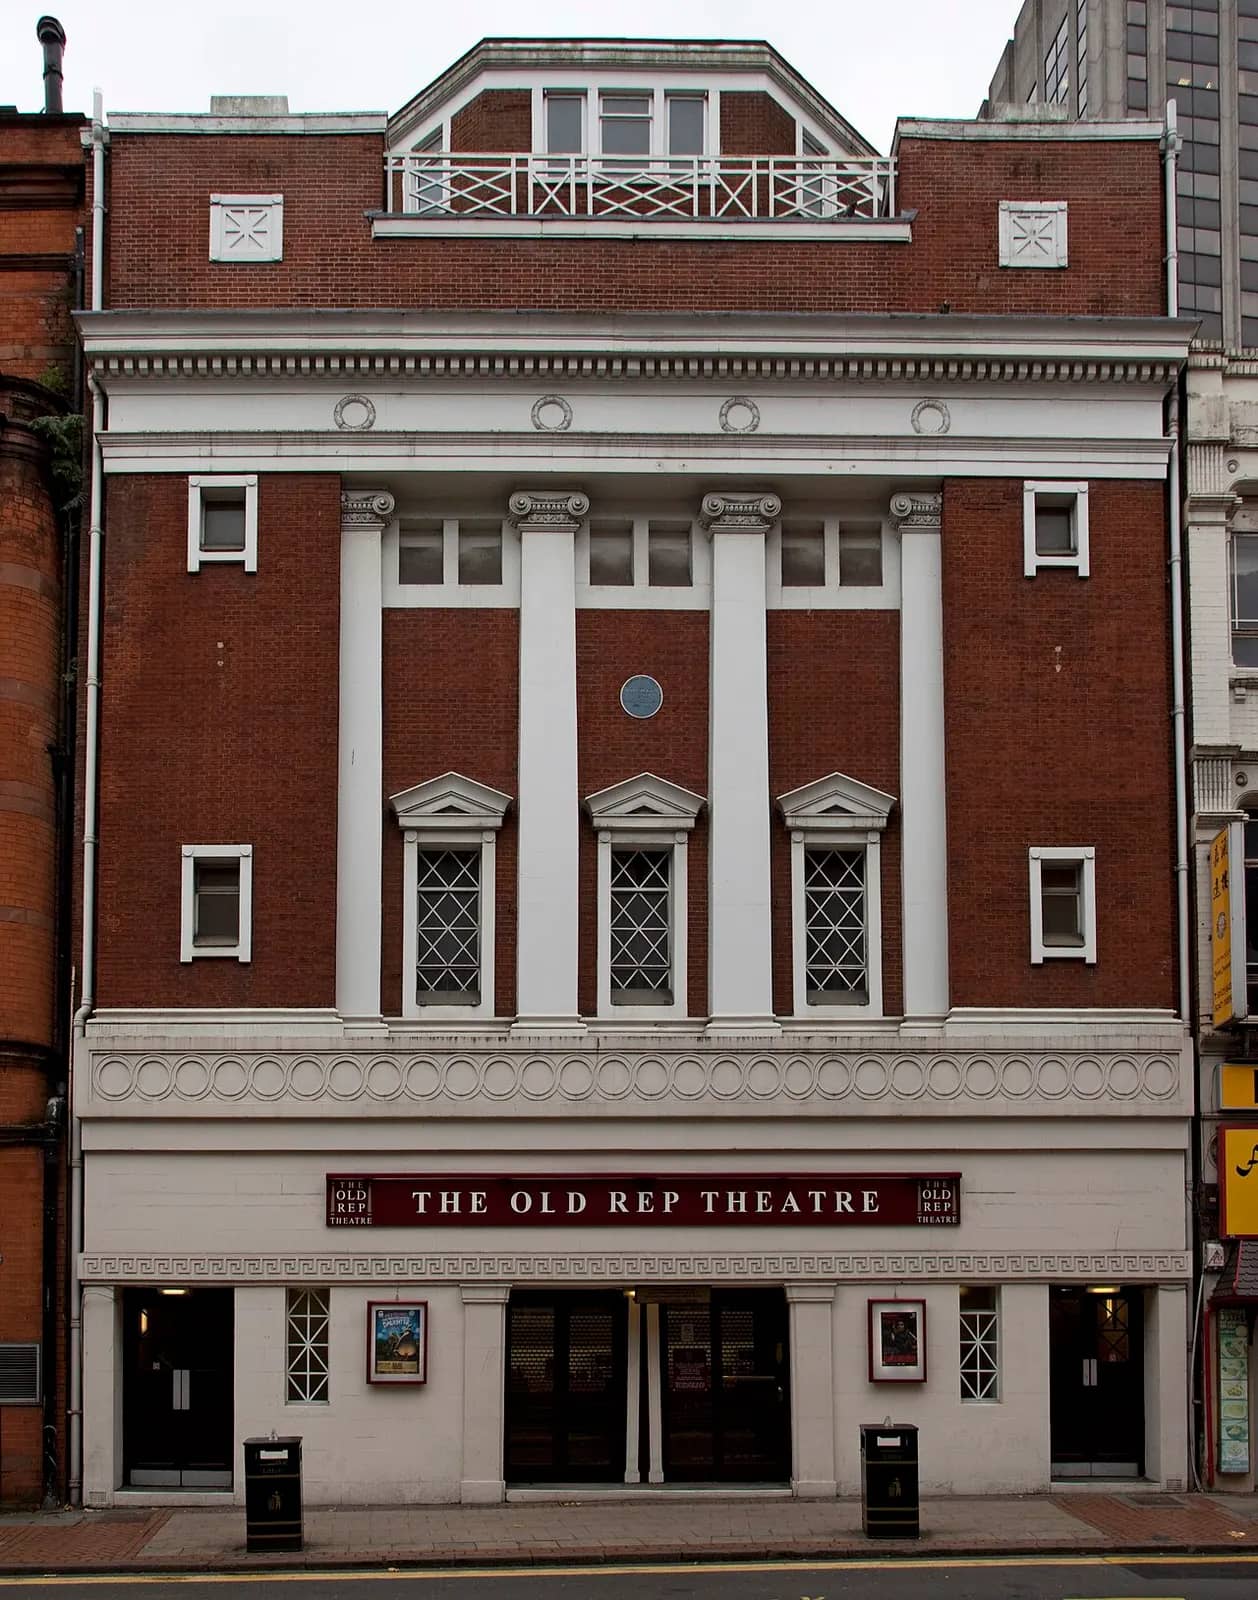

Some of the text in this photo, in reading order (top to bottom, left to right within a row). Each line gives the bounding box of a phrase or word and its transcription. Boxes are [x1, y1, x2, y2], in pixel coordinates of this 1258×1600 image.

[340, 1181, 364, 1189] THE
[926, 1180, 948, 1188] THE
[336, 1190, 367, 1201] OLD
[922, 1189, 952, 1200] OLD
[412, 1190, 880, 1214] THE OLD REP THEATRE
[923, 1202, 952, 1212] REP
[337, 1203, 366, 1213] REP
[330, 1217, 373, 1225] THEATRE
[917, 1216, 958, 1224] THEATRE
